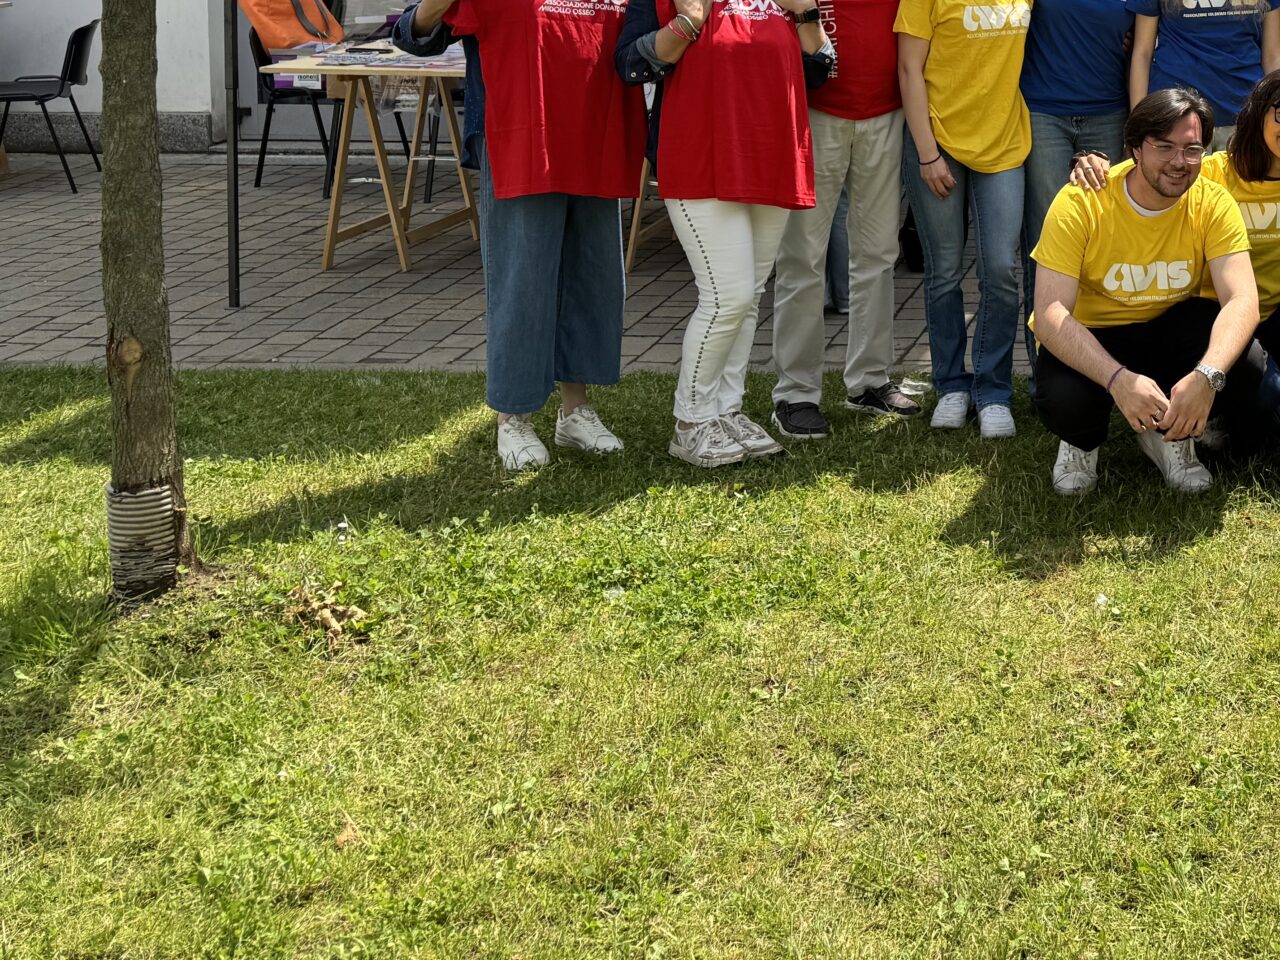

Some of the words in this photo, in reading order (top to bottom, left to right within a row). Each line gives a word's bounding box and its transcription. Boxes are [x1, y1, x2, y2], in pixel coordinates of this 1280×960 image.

[538, 4, 572, 16] MIDOLLO
[572, 7, 596, 16] OSSEO
[1103, 260, 1192, 292] AVIS
